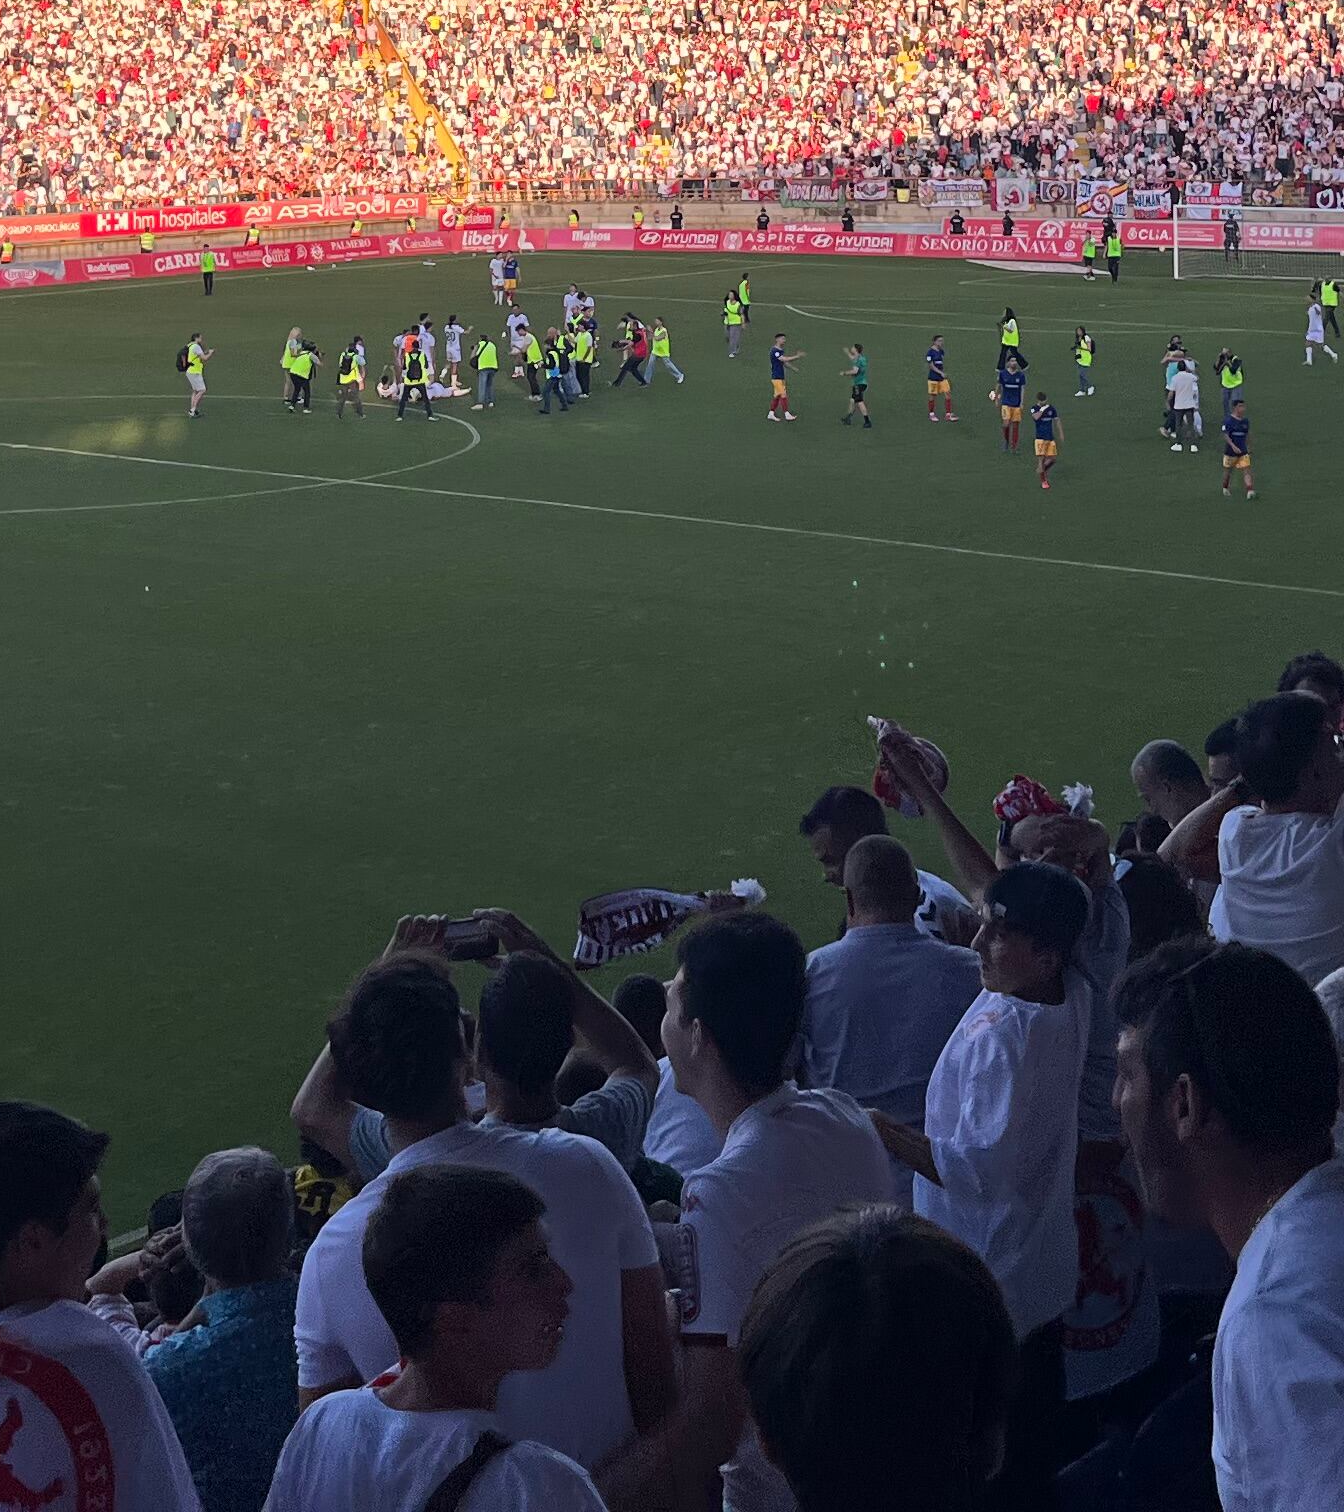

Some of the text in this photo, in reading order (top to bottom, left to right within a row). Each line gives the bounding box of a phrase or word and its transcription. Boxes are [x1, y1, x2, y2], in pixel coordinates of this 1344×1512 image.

[133, 209, 227, 229] hm hospitales
[571, 229, 611, 242] Mahou
[662, 232, 719, 245] HYUNDAI
[744, 231, 805, 244] ASPIRE
[1248, 226, 1314, 238] SORLES
[330, 238, 371, 250] PALMERO
[403, 235, 444, 249] CaixaBank
[462, 230, 509, 248] libery
[834, 235, 894, 249] HYUNDAI
[751, 244, 797, 252] ACADEMY
[991, 238, 1014, 253] DE
[1014, 236, 1059, 256] NAVA
